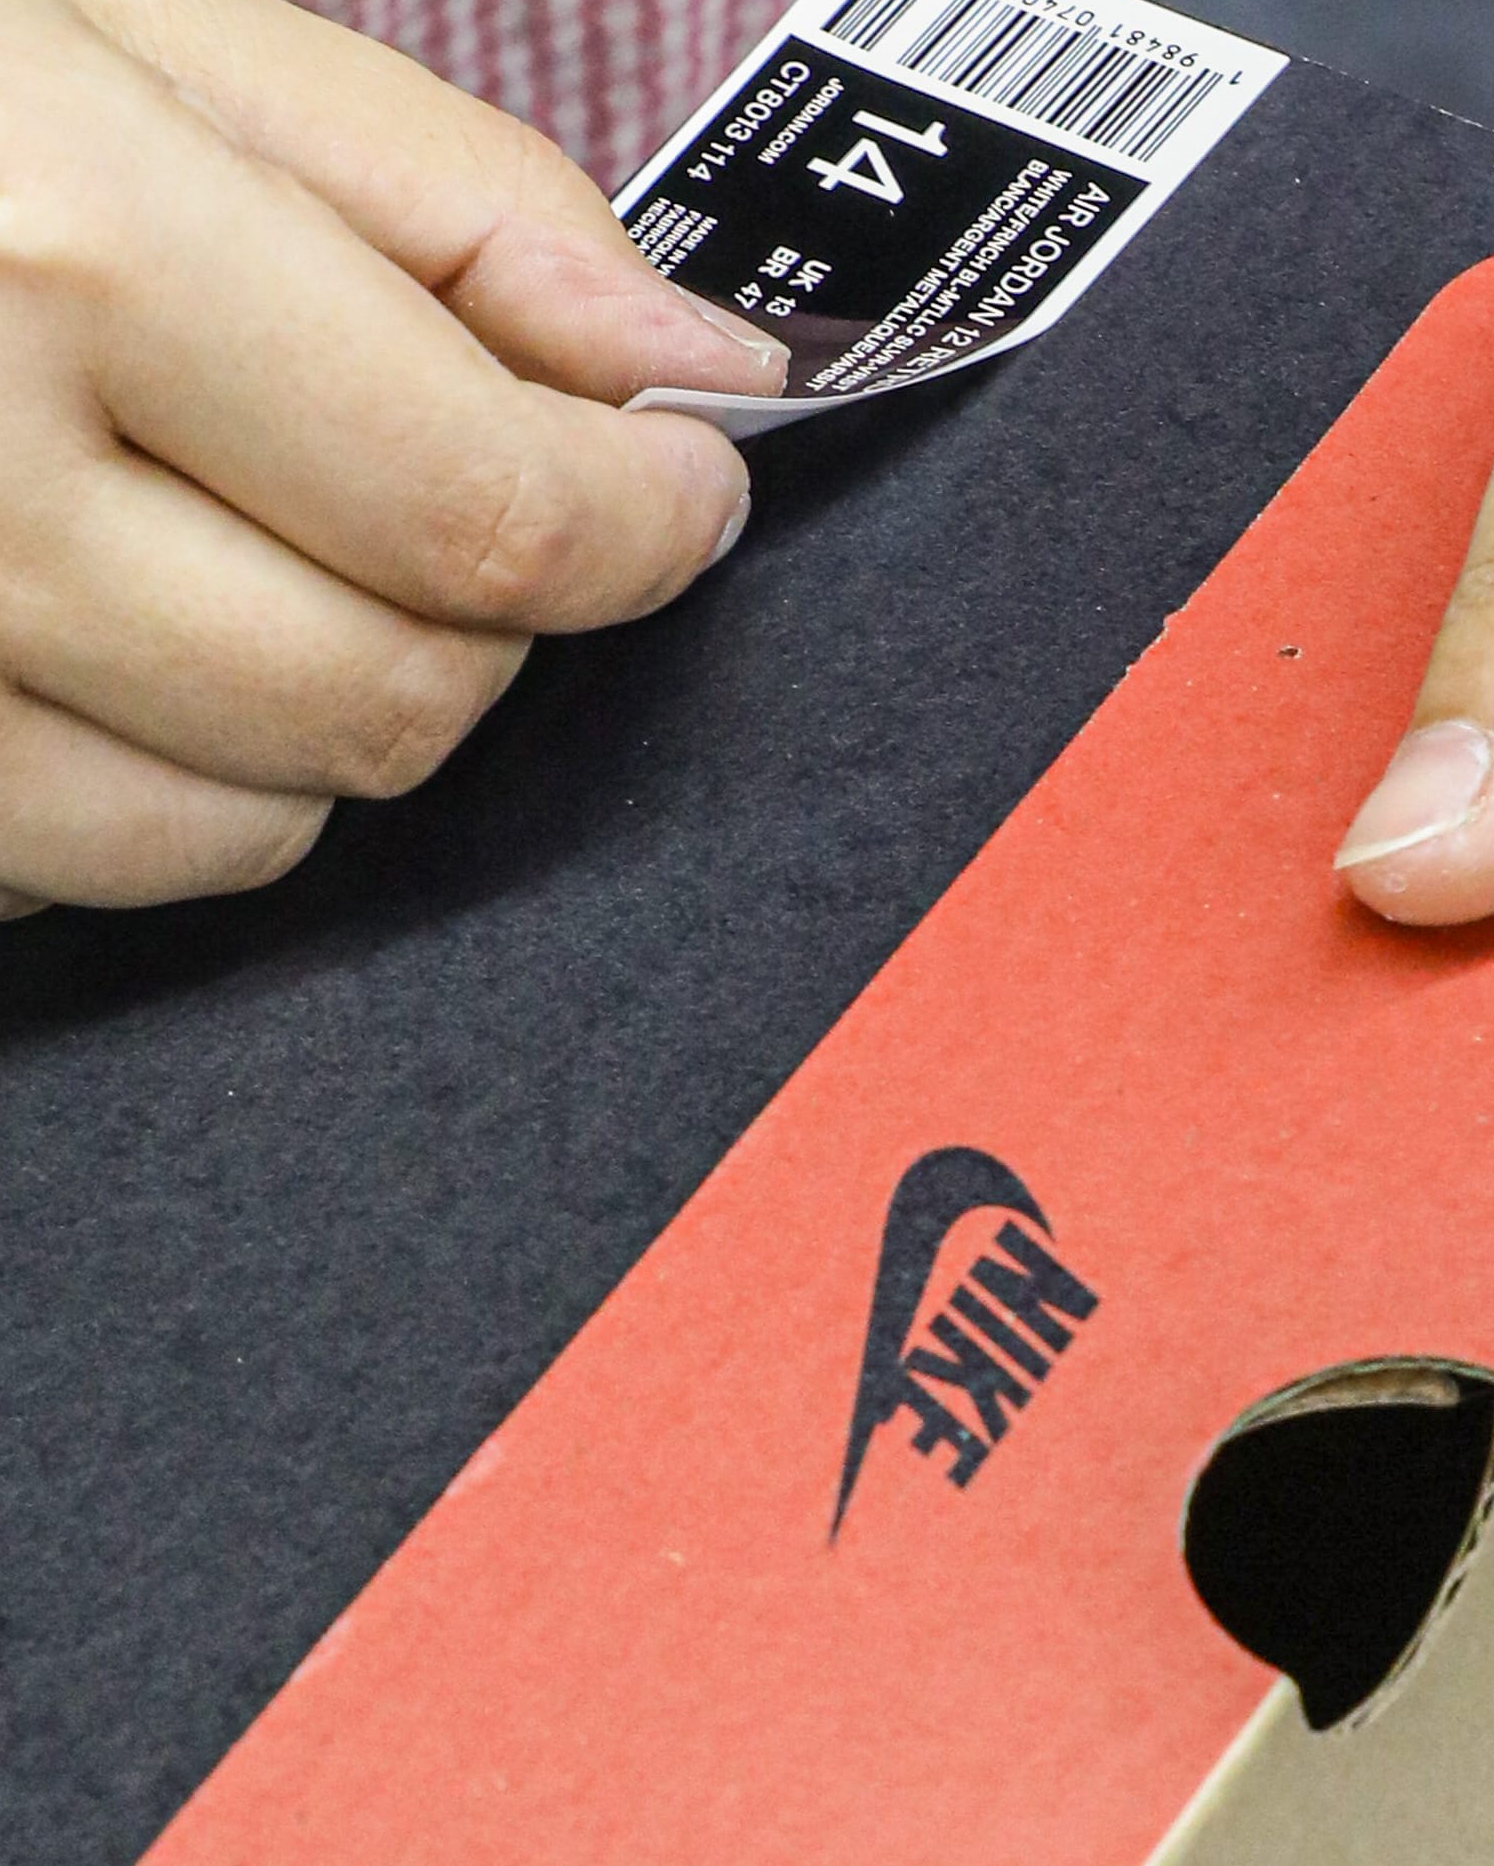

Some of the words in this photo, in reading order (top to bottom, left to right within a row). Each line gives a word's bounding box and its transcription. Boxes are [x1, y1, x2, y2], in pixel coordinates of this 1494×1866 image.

[1109, 22, 1200, 69] 98481
[1228, 69, 1244, 86] 1
[724, 60, 811, 142] CT8013
[757, 77, 845, 165] JORDAN.COM
[686, 141, 736, 182] 114
[807, 109, 950, 205] 14
[938, 157, 1050, 272] BLANC/ARGENT
[968, 168, 1073, 273] WHITE/FRNCH
[1057, 181, 1111, 228] AIR
[686, 215, 719, 252] MADE
[671, 249, 689, 266] IN
[758, 245, 801, 279] BR
[788, 258, 833, 293] UK
[967, 224, 1072, 327] JORDAN
[734, 281, 763, 310] 47
[765, 295, 797, 317] 13
[941, 325, 982, 348] 12
[875, 1219, 1100, 1490] NIKE
